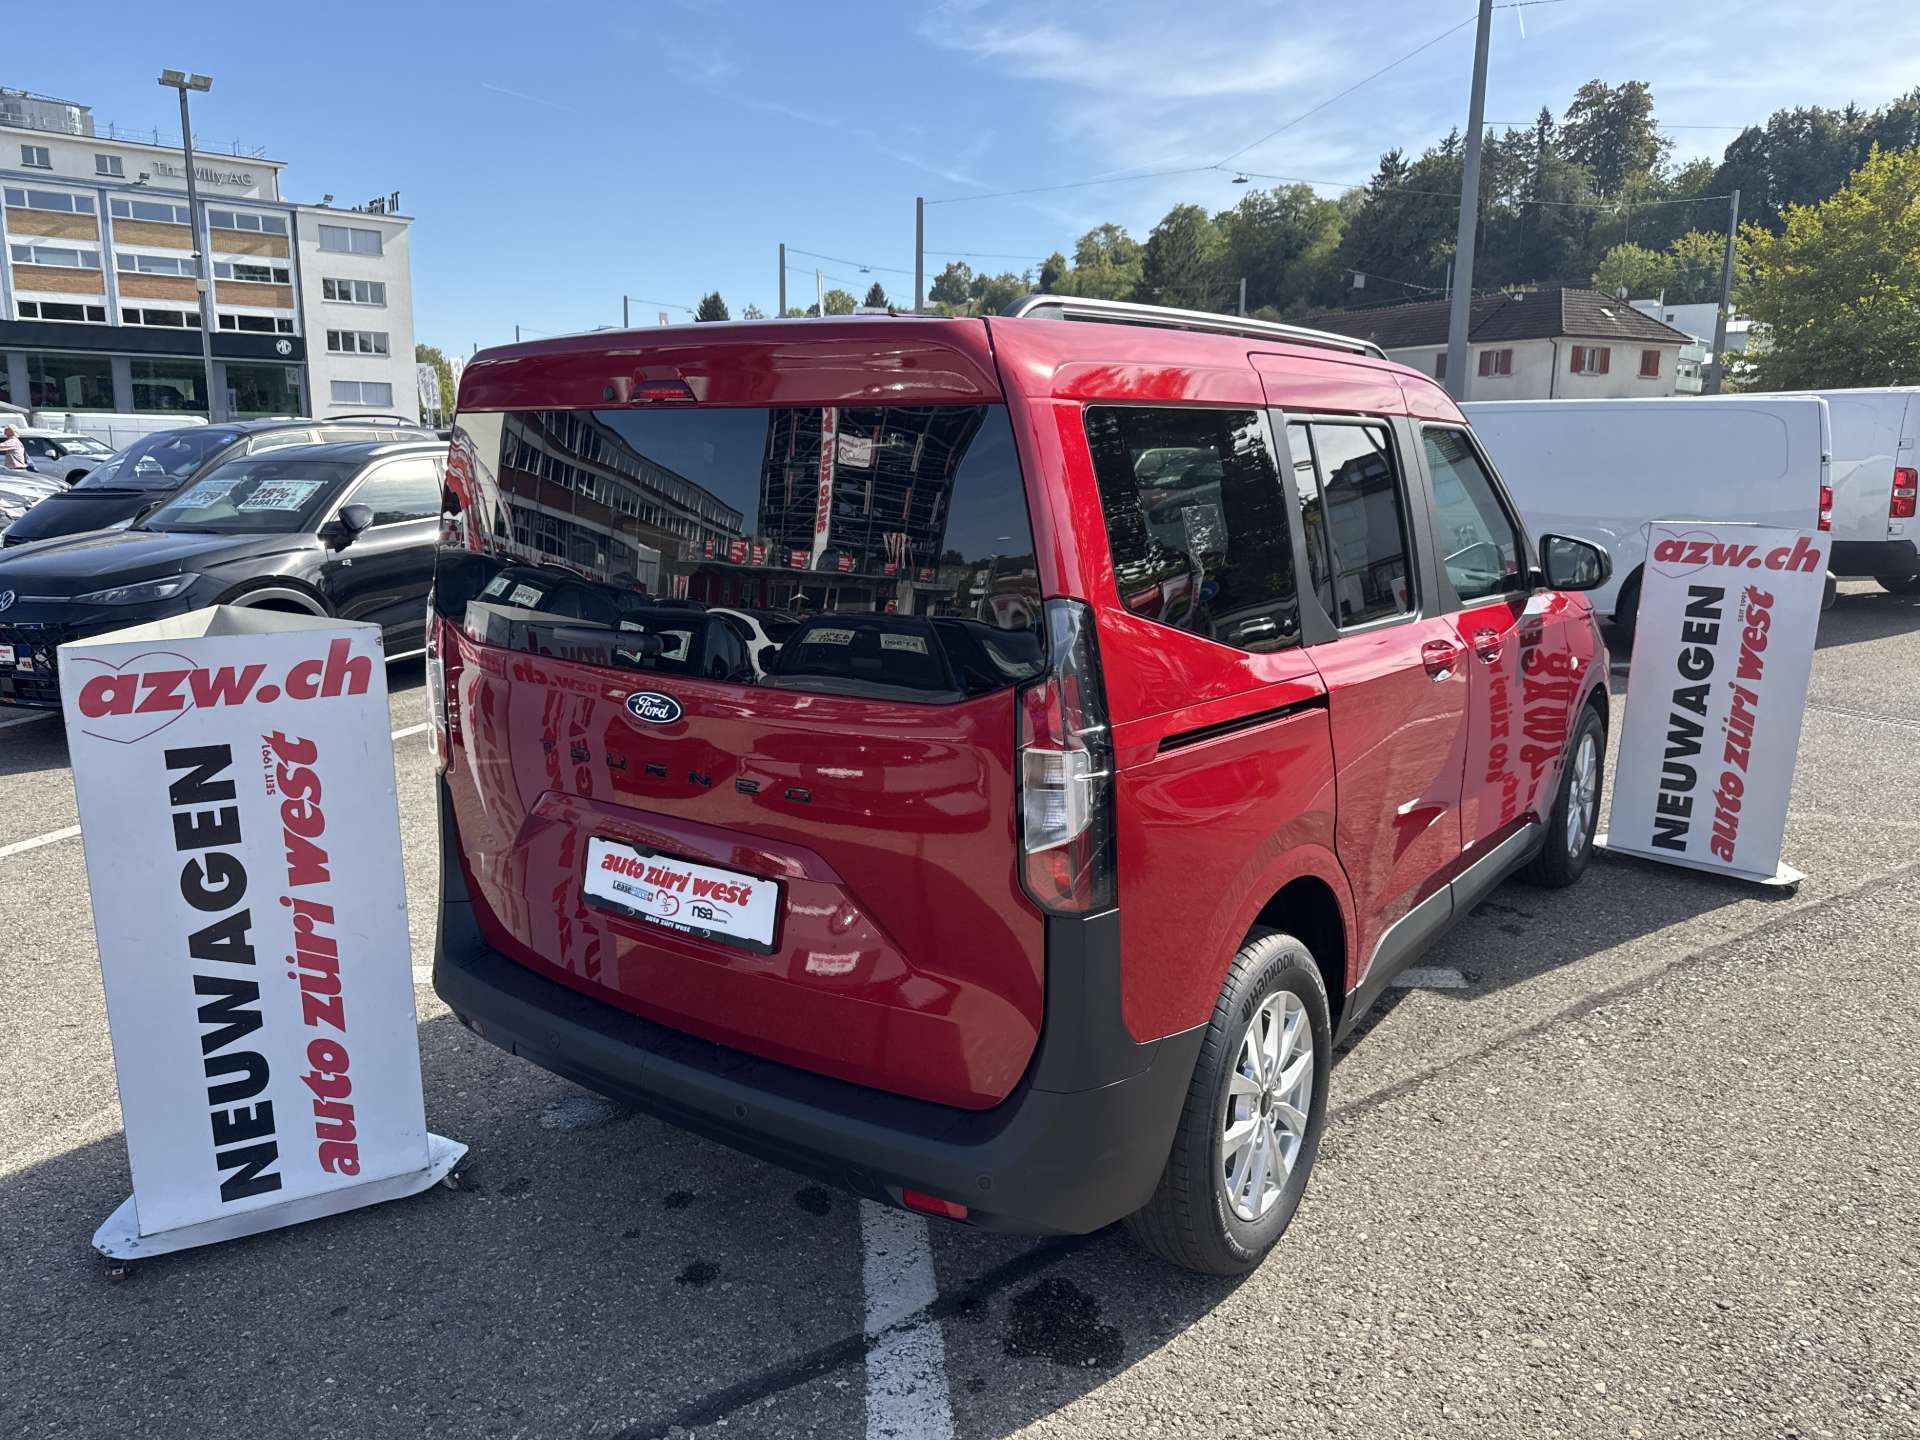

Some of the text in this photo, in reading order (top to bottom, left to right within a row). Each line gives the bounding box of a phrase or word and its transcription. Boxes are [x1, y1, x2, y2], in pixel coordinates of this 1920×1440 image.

[276, 339, 292, 355] MG
[1653, 537, 1822, 573] azw.ch
[79, 638, 373, 718] azw.ch
[636, 695, 669, 719] Ford
[1651, 584, 1726, 853] NEUWAGEN
[1710, 585, 1775, 863] auto züri west
[261, 744, 276, 796] SEIT 1991
[540, 738, 812, 804] TOURNEO
[601, 853, 753, 907] auto züri west
[692, 905, 713, 921] nsa
[164, 743, 283, 1204] NEUWAGEN
[261, 730, 361, 1177] auto züri west
